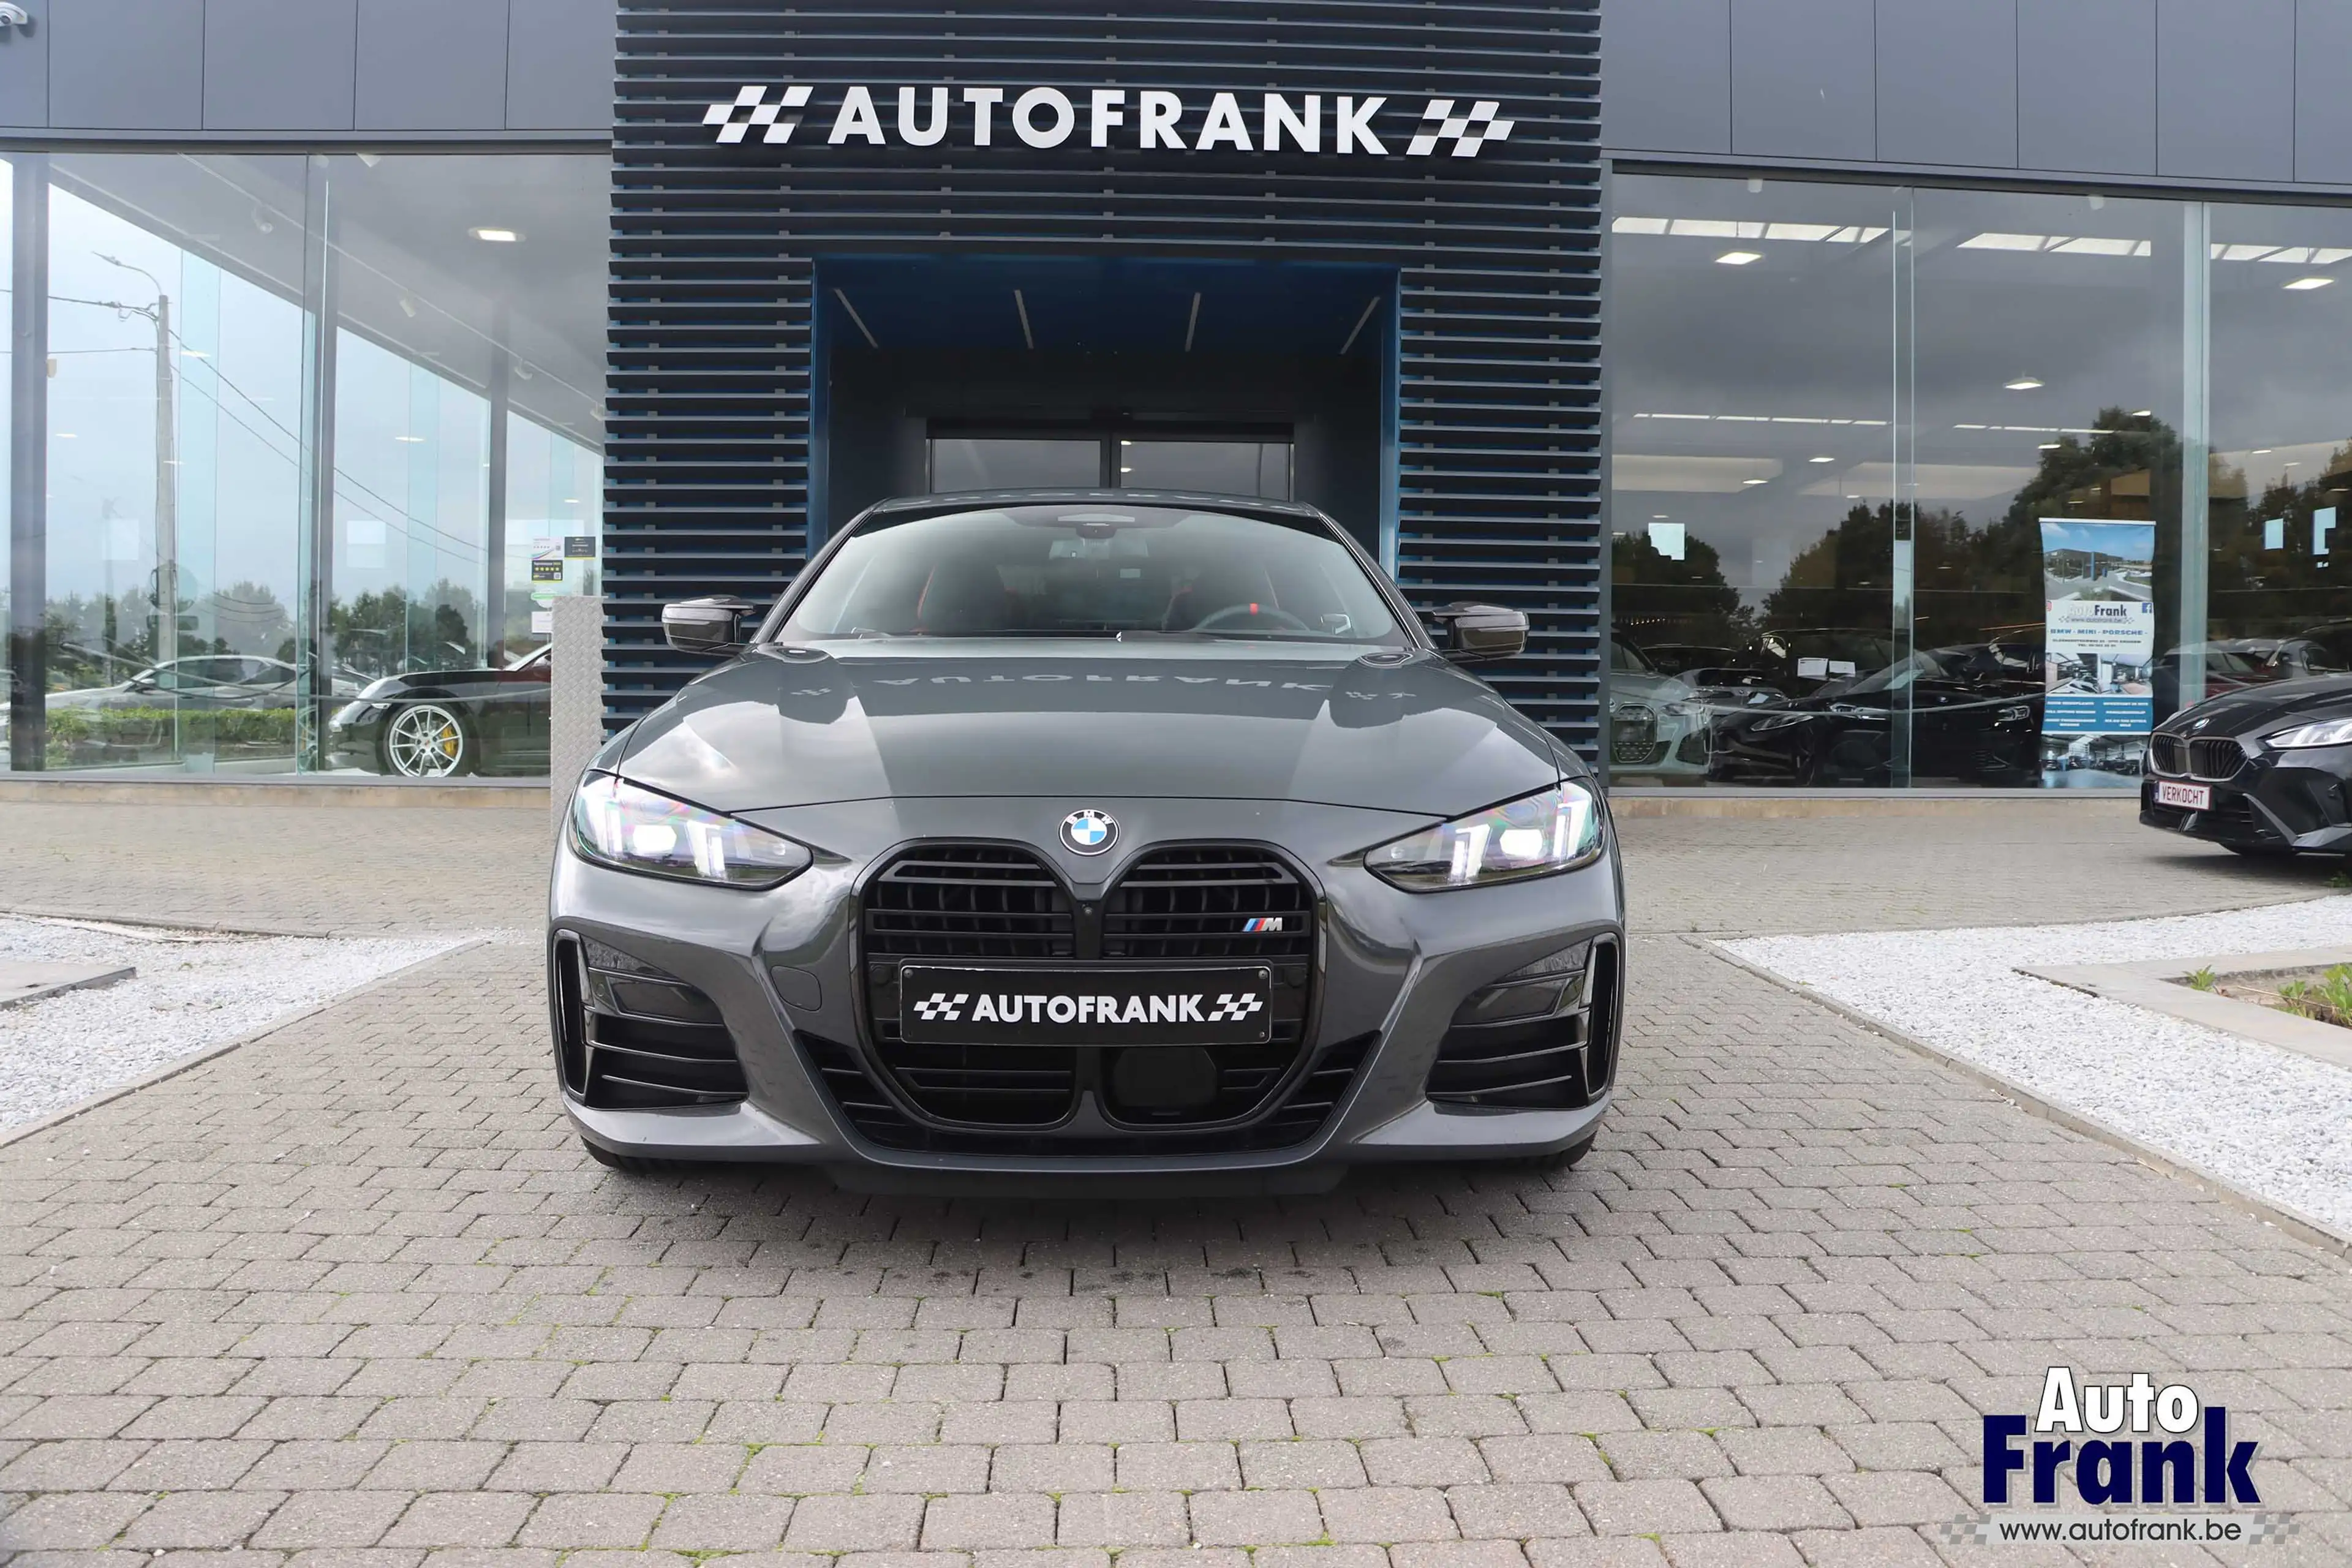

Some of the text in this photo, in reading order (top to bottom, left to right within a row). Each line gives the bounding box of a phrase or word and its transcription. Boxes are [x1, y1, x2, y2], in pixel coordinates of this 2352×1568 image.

[827, 86, 1389, 154] AUTOFRANK
[2095, 604, 2127, 616] Frank
[2162, 786, 2204, 805] VERKOCHT
[1066, 810, 1114, 824] BMW
[1260, 918, 1283, 932] M
[971, 994, 1205, 1023] AUTOFRANK
